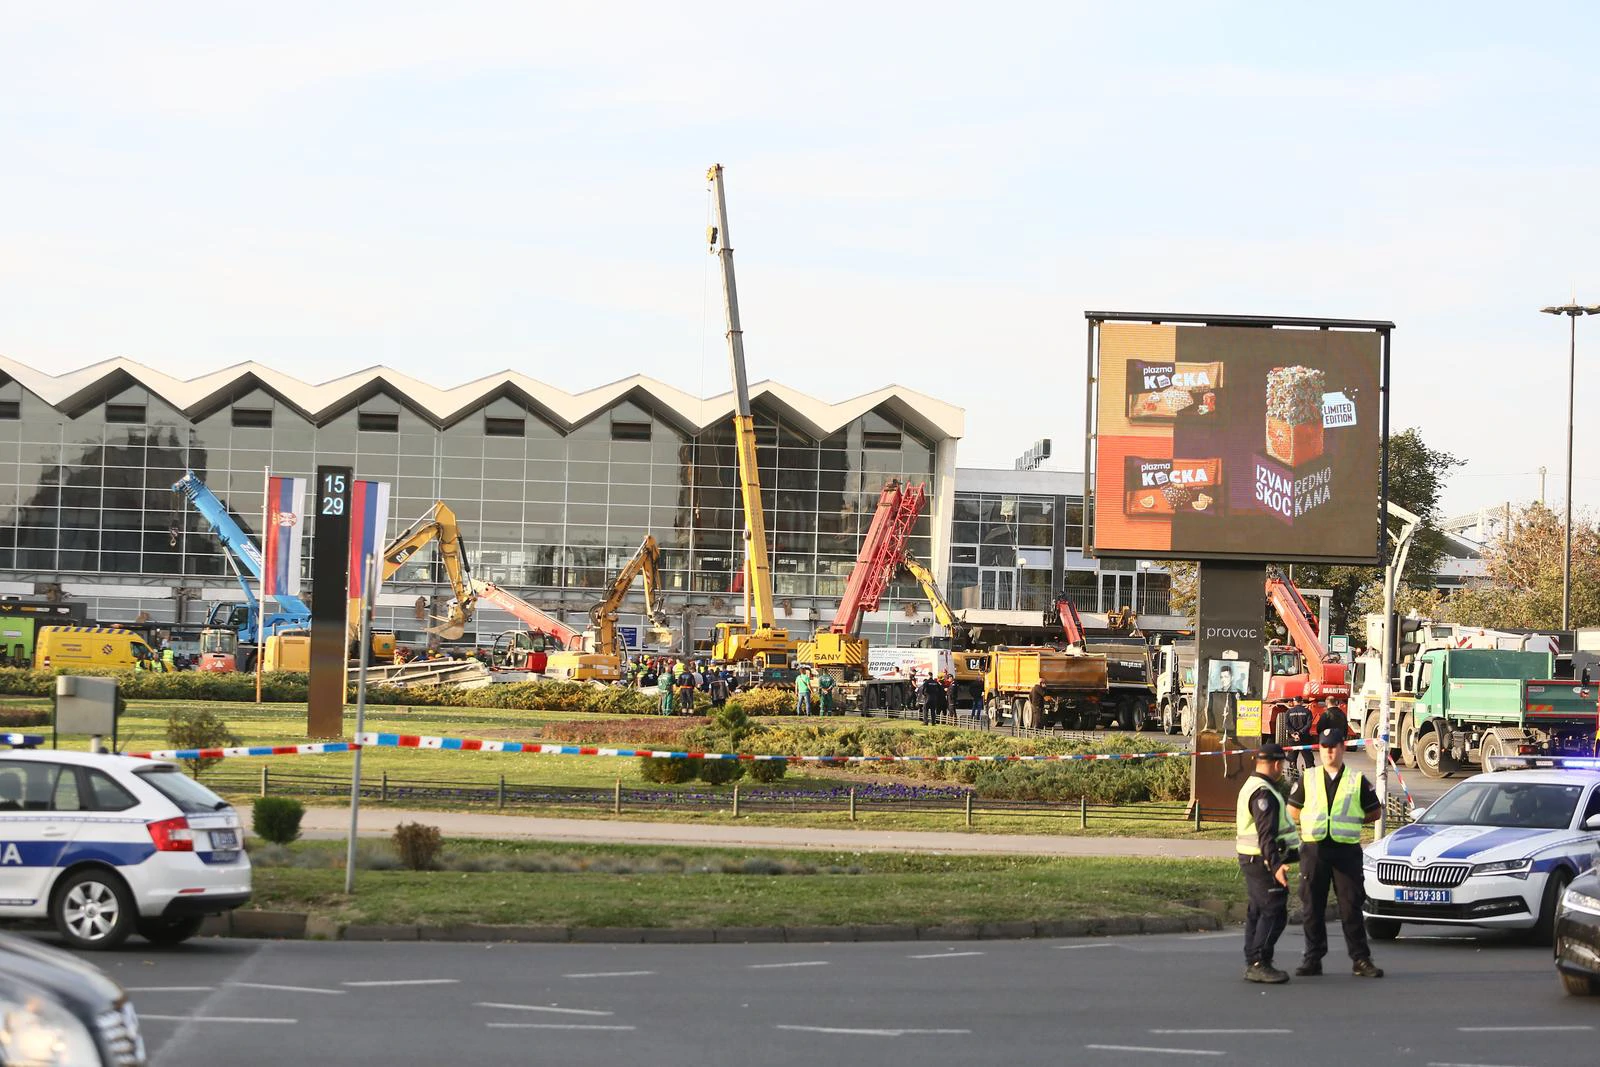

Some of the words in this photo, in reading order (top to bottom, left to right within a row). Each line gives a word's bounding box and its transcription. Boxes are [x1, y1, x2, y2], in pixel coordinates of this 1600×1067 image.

[1143, 366, 1173, 375] plazma
[1324, 403, 1352, 415] LIMITED
[1325, 413, 1353, 425] EDITION
[1141, 463, 1170, 473] plazma
[325, 474, 345, 493] 15
[1256, 464, 1292, 496] IZVAN
[1294, 466, 1332, 498] REDNO
[322, 496, 344, 515] 29
[1255, 482, 1292, 517] SKOC
[1294, 484, 1331, 518] KANA
[395, 549, 410, 563] CAT
[1206, 627, 1257, 640] pravac
[814, 653, 841, 661] SANY
[0, 842, 24, 865] A
